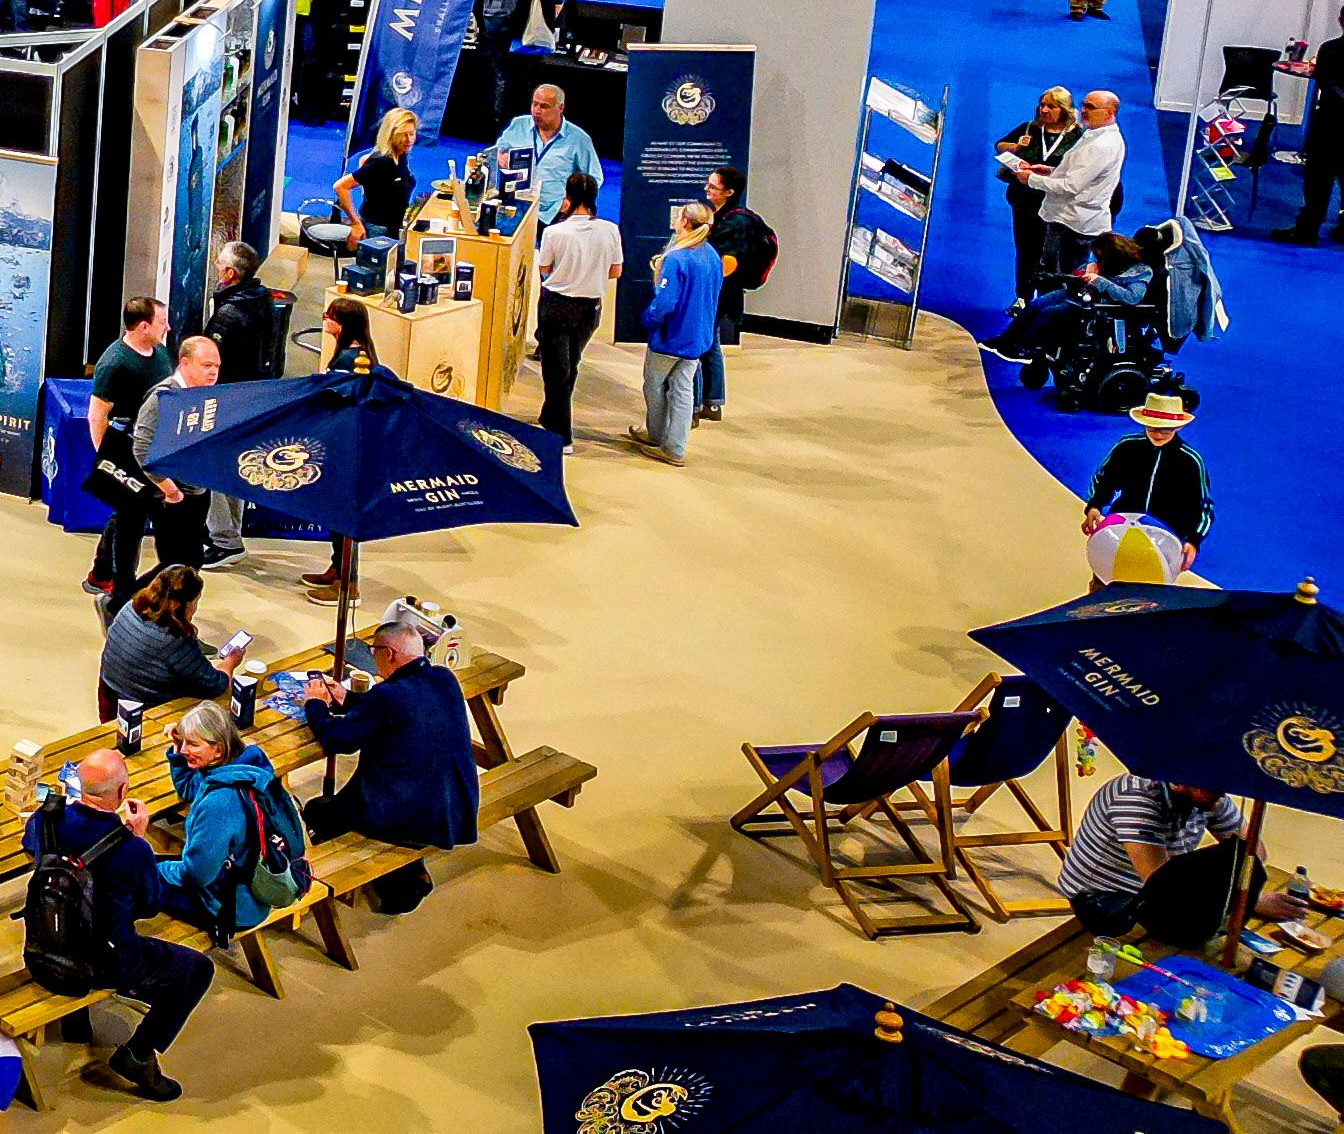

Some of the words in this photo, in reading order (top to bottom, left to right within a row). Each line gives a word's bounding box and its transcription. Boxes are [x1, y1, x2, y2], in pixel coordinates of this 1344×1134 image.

[97, 458, 146, 494] B&G
[390, 473, 480, 495] MERMAID
[424, 487, 461, 505] GIN
[1078, 646, 1162, 708] MERMAID
[1083, 669, 1123, 702] GIN
